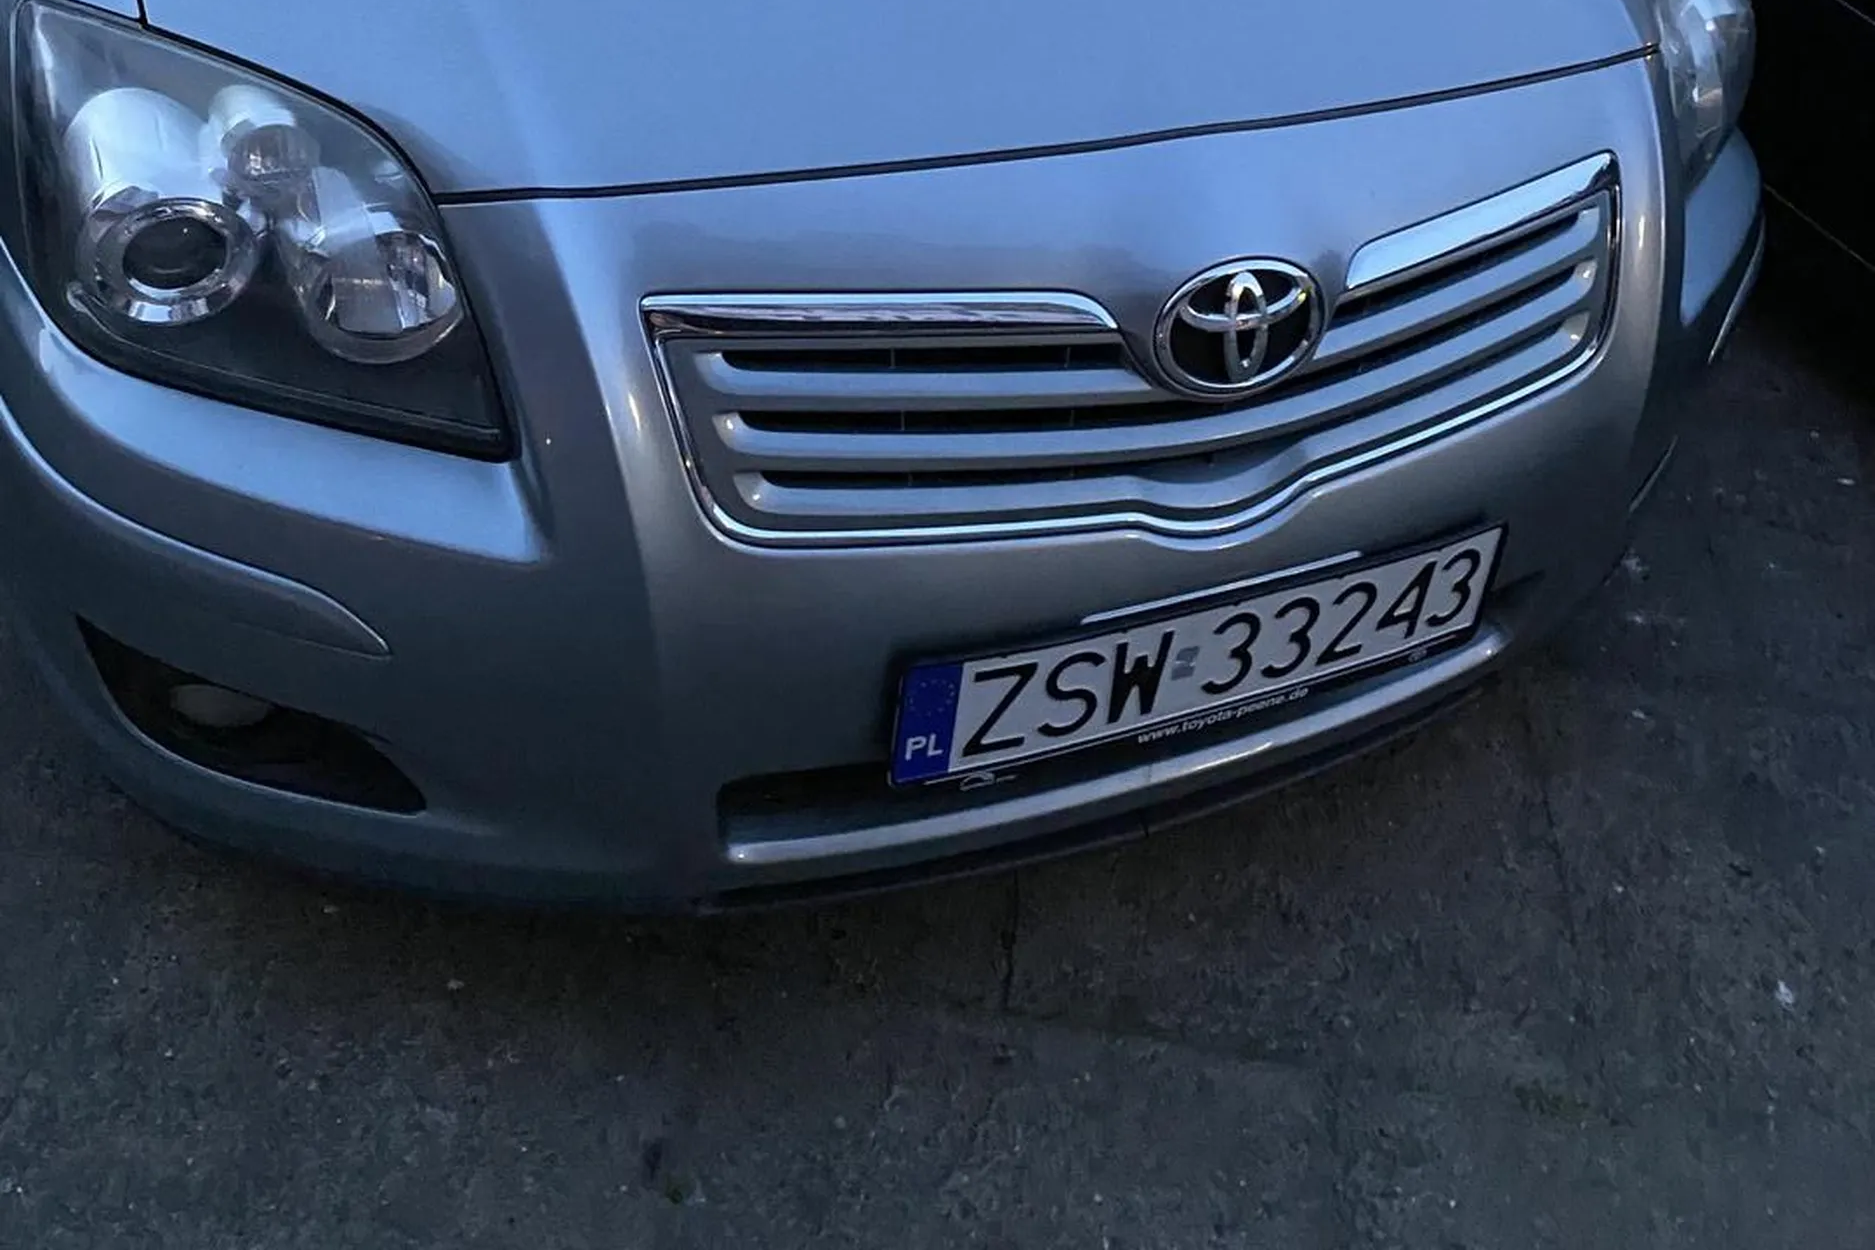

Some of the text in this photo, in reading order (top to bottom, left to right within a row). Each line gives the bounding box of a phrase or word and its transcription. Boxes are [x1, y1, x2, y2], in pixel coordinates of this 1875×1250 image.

[962, 548, 1482, 758] ZSW 33243
[1137, 686, 1310, 744] www.toyota-peene.de
[904, 733, 944, 761] PL
